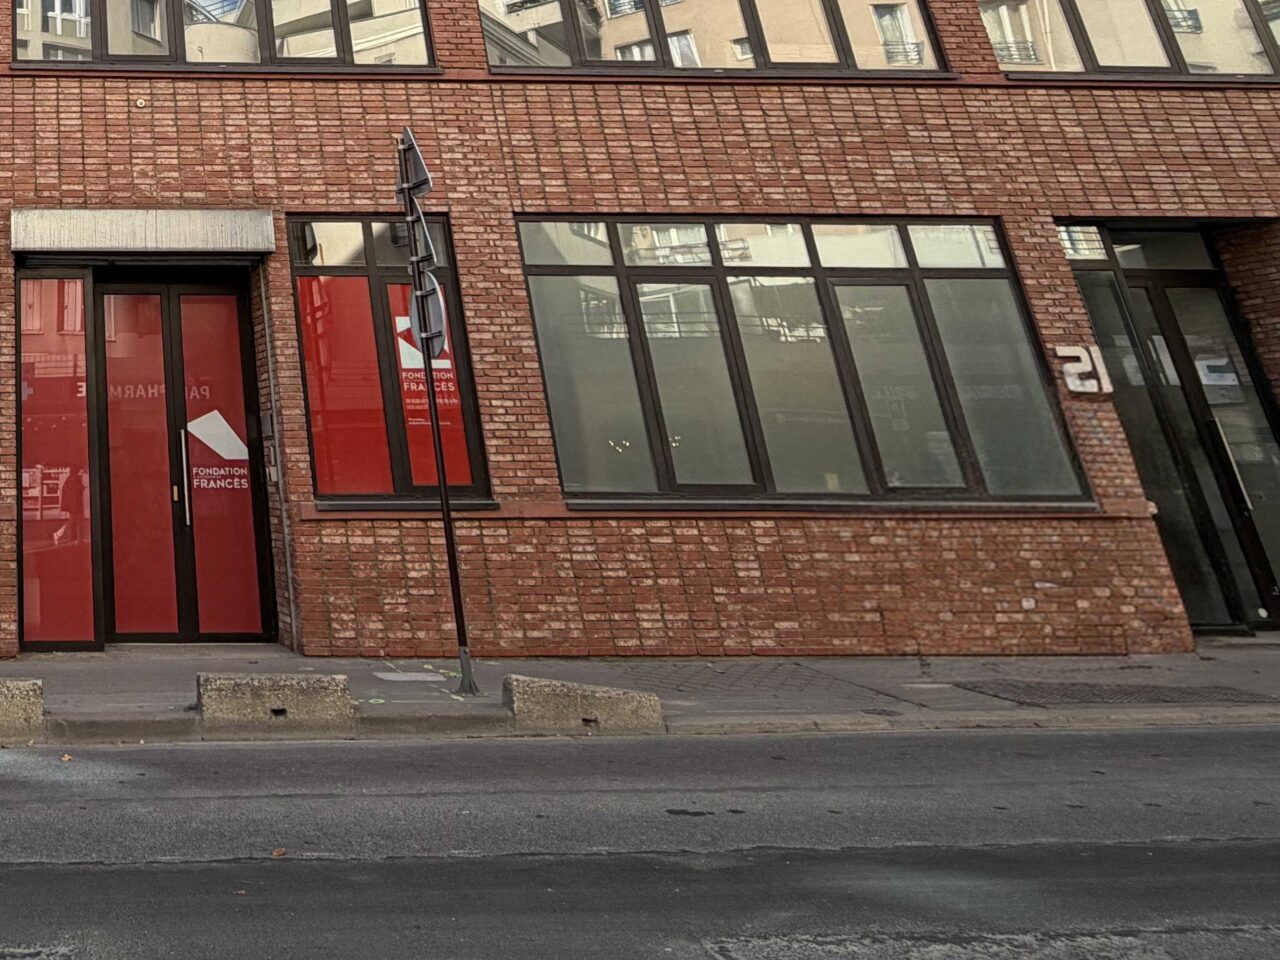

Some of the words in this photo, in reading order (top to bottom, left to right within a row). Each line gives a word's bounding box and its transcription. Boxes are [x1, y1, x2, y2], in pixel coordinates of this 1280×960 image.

[1055, 346, 1114, 393] 21
[402, 371, 454, 379] FONDTION
[403, 381, 455, 391] FRACÈS
[192, 467, 248, 476] FONDATION
[193, 477, 249, 489] FRANCÈS
